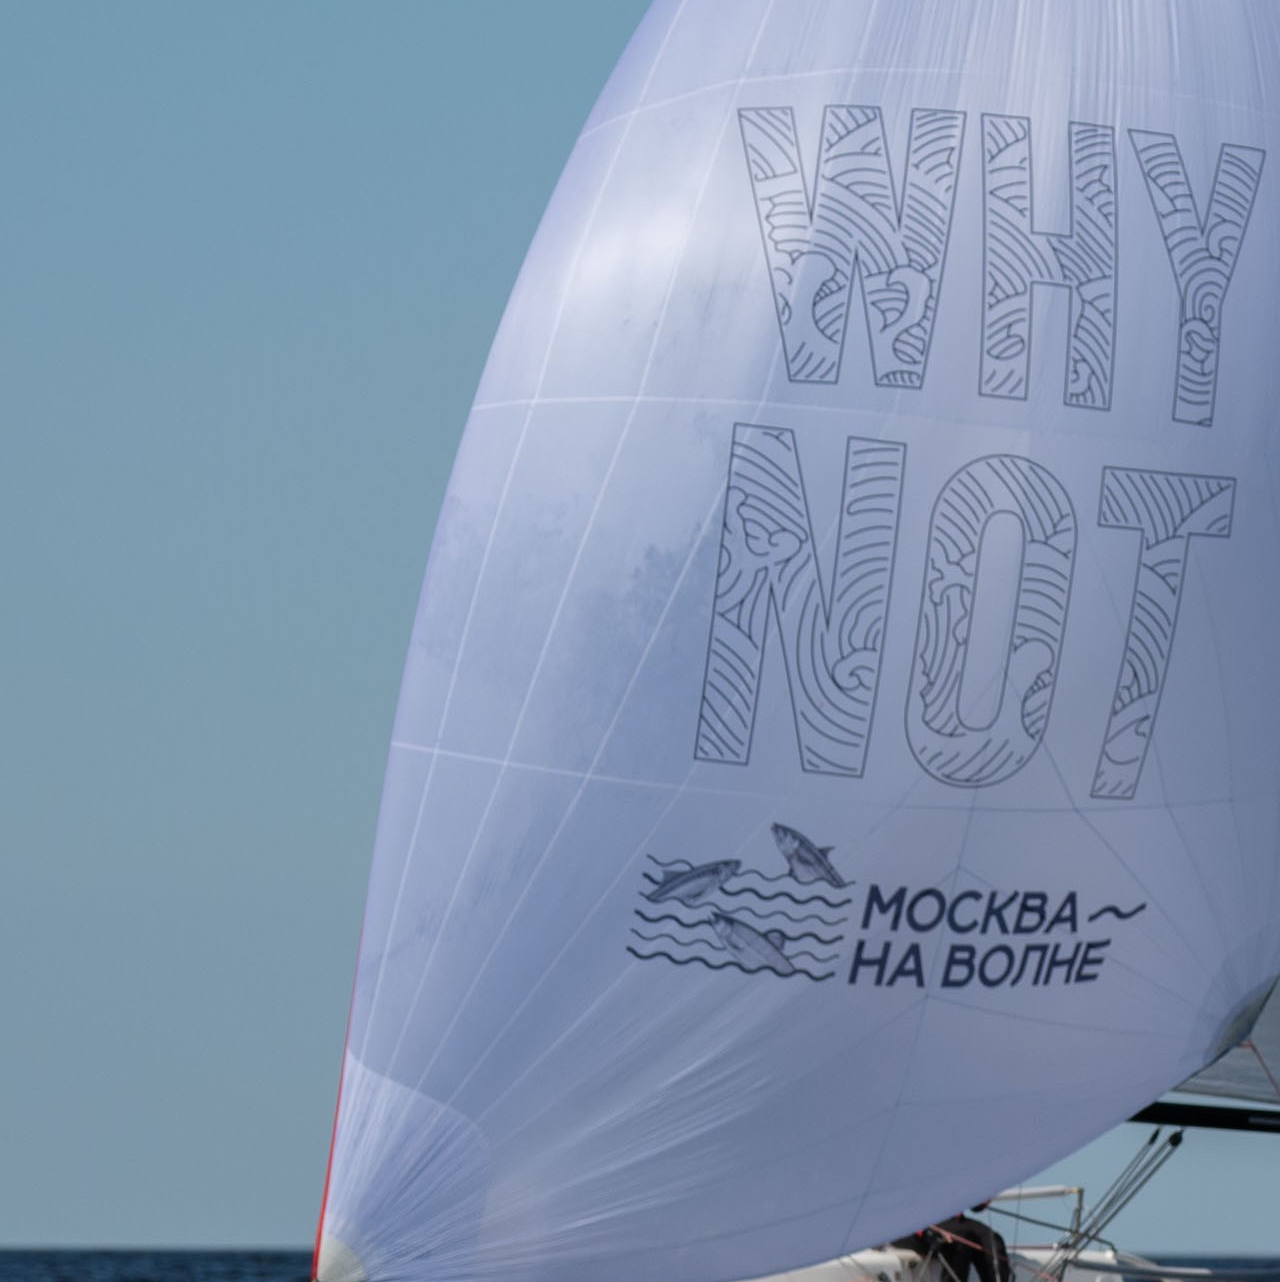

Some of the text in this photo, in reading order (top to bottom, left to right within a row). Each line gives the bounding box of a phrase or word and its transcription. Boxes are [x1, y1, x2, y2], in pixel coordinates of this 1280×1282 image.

[737, 103, 1267, 428] WHY
[694, 421, 1238, 800] NOT
[847, 938, 1112, 988] НА ВОЛНЕ
[860, 884, 1079, 935] МОСКВА
